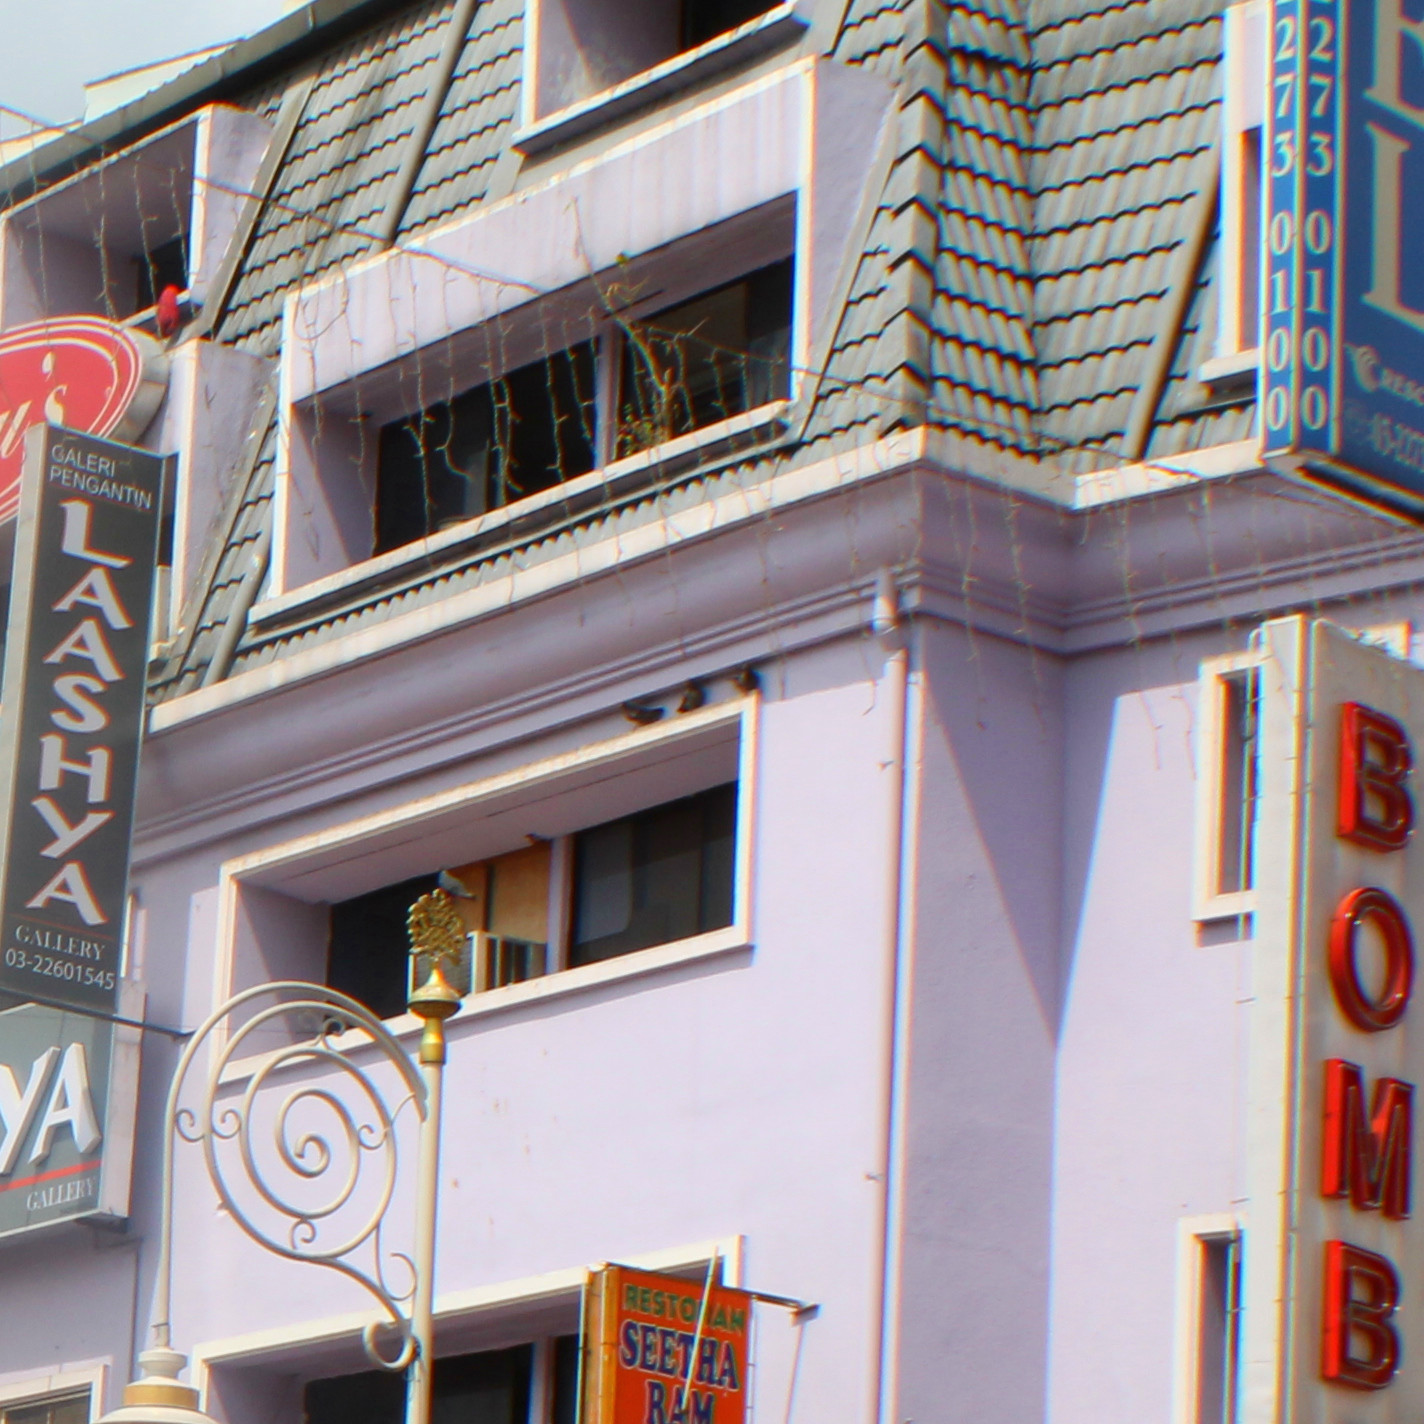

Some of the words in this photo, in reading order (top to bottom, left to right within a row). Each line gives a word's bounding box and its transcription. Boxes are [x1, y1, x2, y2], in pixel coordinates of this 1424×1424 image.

[51, 444, 116, 478] GALERI
[49, 469, 152, 511] PENGANTIN
[25, 498, 134, 926] LAASHYA
[15, 923, 105, 962] GALLERY
[5, 947, 115, 991] 03-22601545
[26, 1177, 95, 1213] GALLERY
[622, 1283, 744, 1336] RESTOAN
